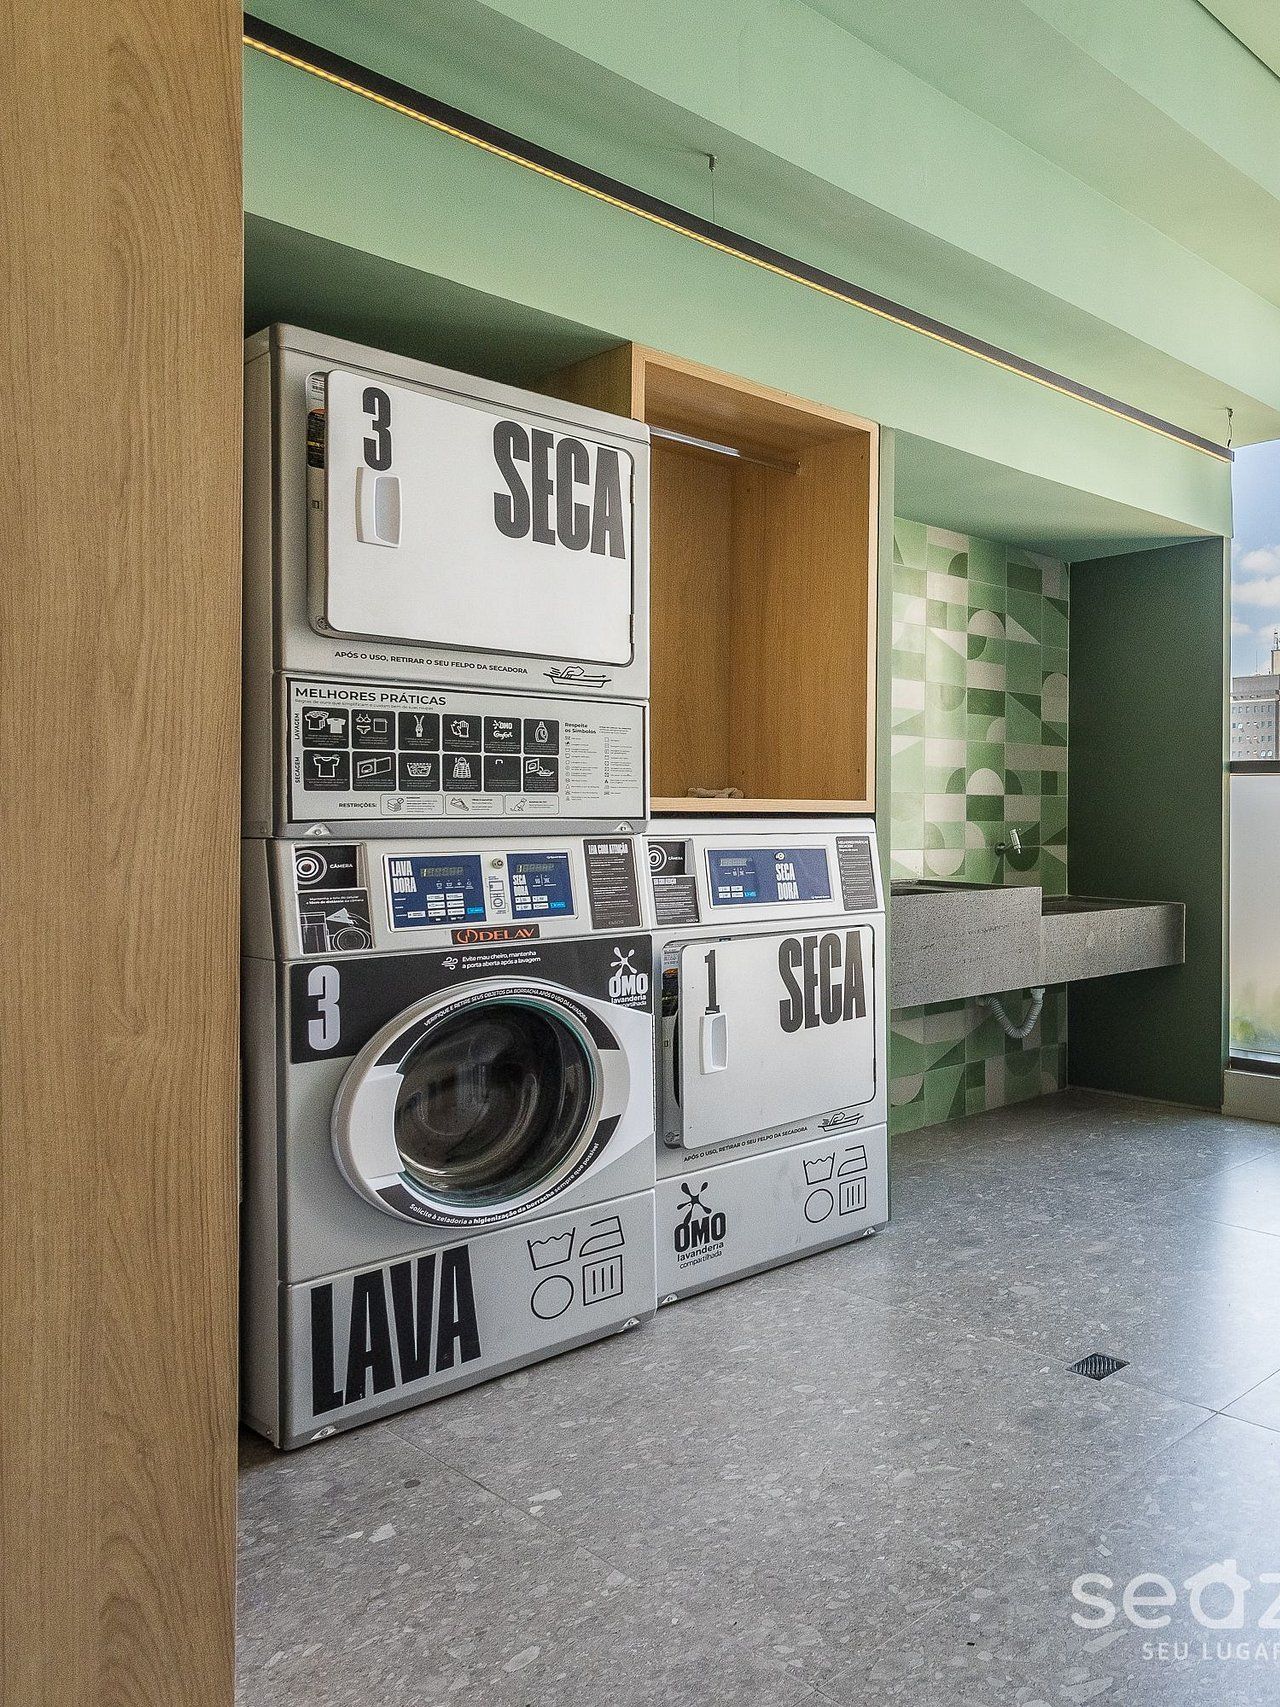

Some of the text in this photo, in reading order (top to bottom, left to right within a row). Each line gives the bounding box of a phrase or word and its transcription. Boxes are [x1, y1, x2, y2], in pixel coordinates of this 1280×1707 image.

[362, 387, 392, 471] 3
[493, 420, 626, 560] SECA
[334, 650, 359, 659] APÓS
[369, 653, 389, 662] USO,
[391, 655, 424, 665] RETIRAR
[434, 659, 449, 667] SEU
[451, 660, 475, 669] FELPO
[476, 663, 488, 671] DA
[489, 664, 528, 674] SECADORA
[295, 687, 447, 706] MELHORES PRÁTICAS
[390, 860, 413, 877] LAVA
[775, 862, 796, 881] SECA
[392, 876, 417, 893] DORA
[777, 881, 800, 900] DORA
[466, 962, 482, 970] porta
[482, 959, 501, 967] aberta
[501, 958, 514, 966] após
[518, 956, 541, 965] lavagem
[509, 951, 537, 959] mantenha
[608, 973, 648, 998] OMO
[704, 949, 720, 1014] 1
[778, 930, 866, 1033] SECA
[307, 965, 341, 1051] 3
[423, 1005, 450, 1026] VERIFIQUE
[471, 993, 484, 1003] SEUS
[611, 993, 647, 1004] lavanderia
[684, 1154, 699, 1162] APÓS
[719, 1143, 741, 1153] RETIRAR
[746, 1138, 757, 1146] SEU
[757, 1134, 773, 1143] FELPO
[781, 1126, 808, 1136] SECADORA
[409, 1203, 432, 1218] Solicite
[437, 1215, 468, 1225] zeladoria
[473, 1209, 517, 1224] higienização
[517, 1206, 527, 1214] da
[526, 1190, 555, 1209] borracha
[554, 1174, 575, 1193] sempre
[573, 1164, 585, 1176] que
[674, 1212, 726, 1252] OMO
[677, 1242, 724, 1262] lavanderia
[679, 1250, 722, 1269] compartilhada
[310, 1244, 482, 1417] LAVA
